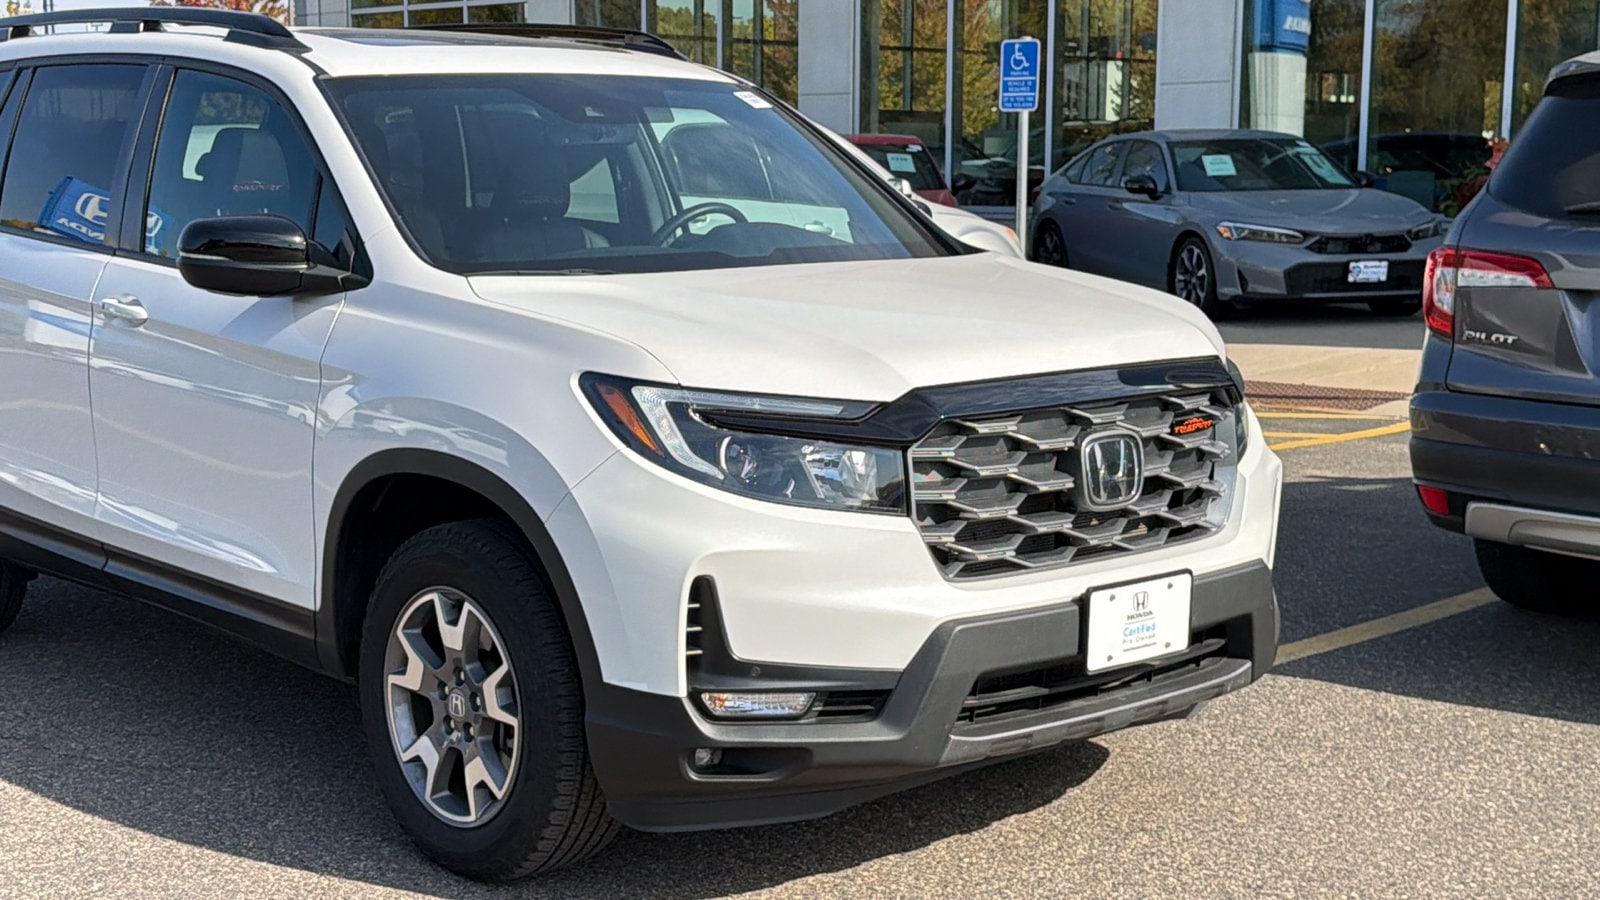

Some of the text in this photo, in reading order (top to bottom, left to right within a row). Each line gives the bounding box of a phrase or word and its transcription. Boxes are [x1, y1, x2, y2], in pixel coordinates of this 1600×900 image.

[1461, 329, 1519, 344] PILOT
[1126, 610, 1153, 621] HONDA
[1122, 621, 1156, 638] Certified
